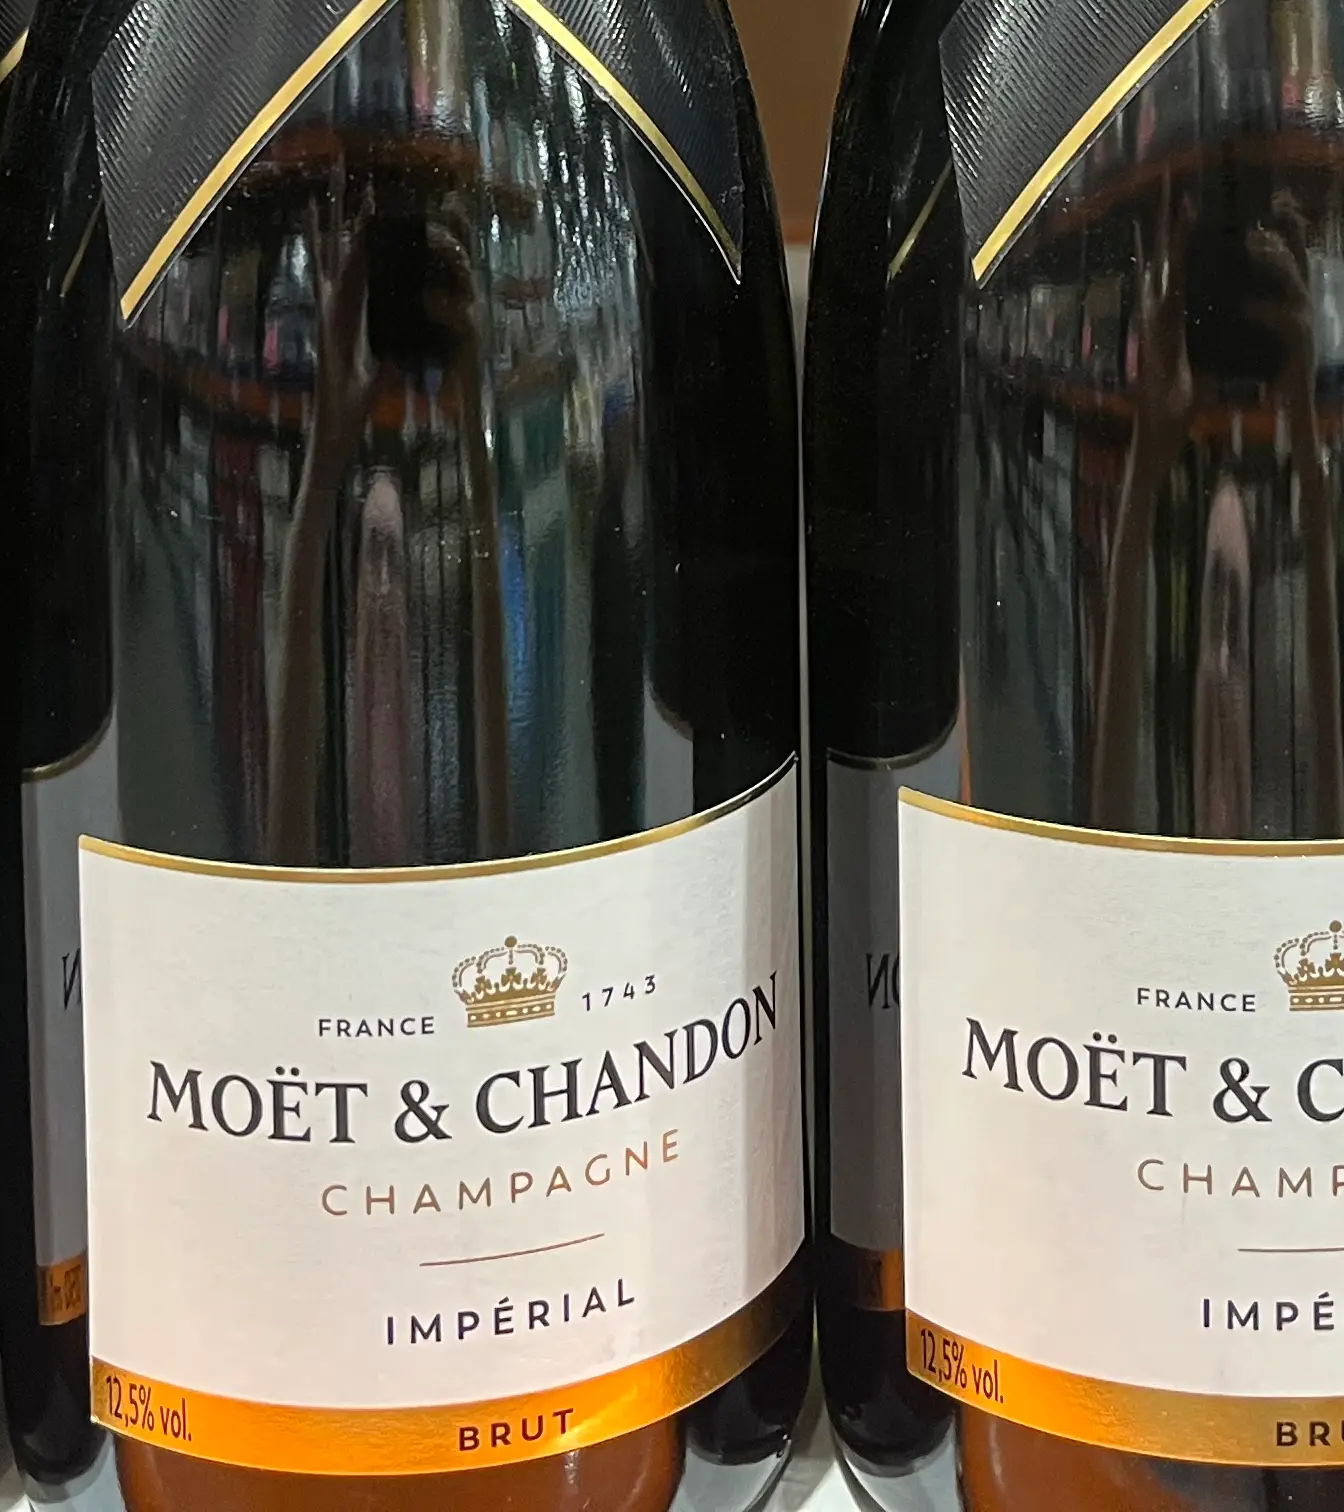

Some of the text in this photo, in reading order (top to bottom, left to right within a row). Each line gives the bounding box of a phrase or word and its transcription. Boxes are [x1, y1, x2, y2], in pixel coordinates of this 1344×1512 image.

[318, 974, 658, 1039] FRANCE 1743
[1137, 986, 1257, 1013] FRANCE
[146, 1059, 369, 1144] MOËT
[393, 1078, 453, 1144] &
[475, 970, 779, 1136] CHANDON
[961, 1016, 1188, 1119] MOËT
[1211, 1056, 1273, 1124] &
[321, 1128, 680, 1216] CHAMPAGNE
[387, 1278, 636, 1347] IMPÉRIAL
[920, 1327, 1005, 1405] 12,5% vol.
[105, 1375, 193, 1443] 12,5% vol.
[458, 1407, 575, 1453] BRUT
